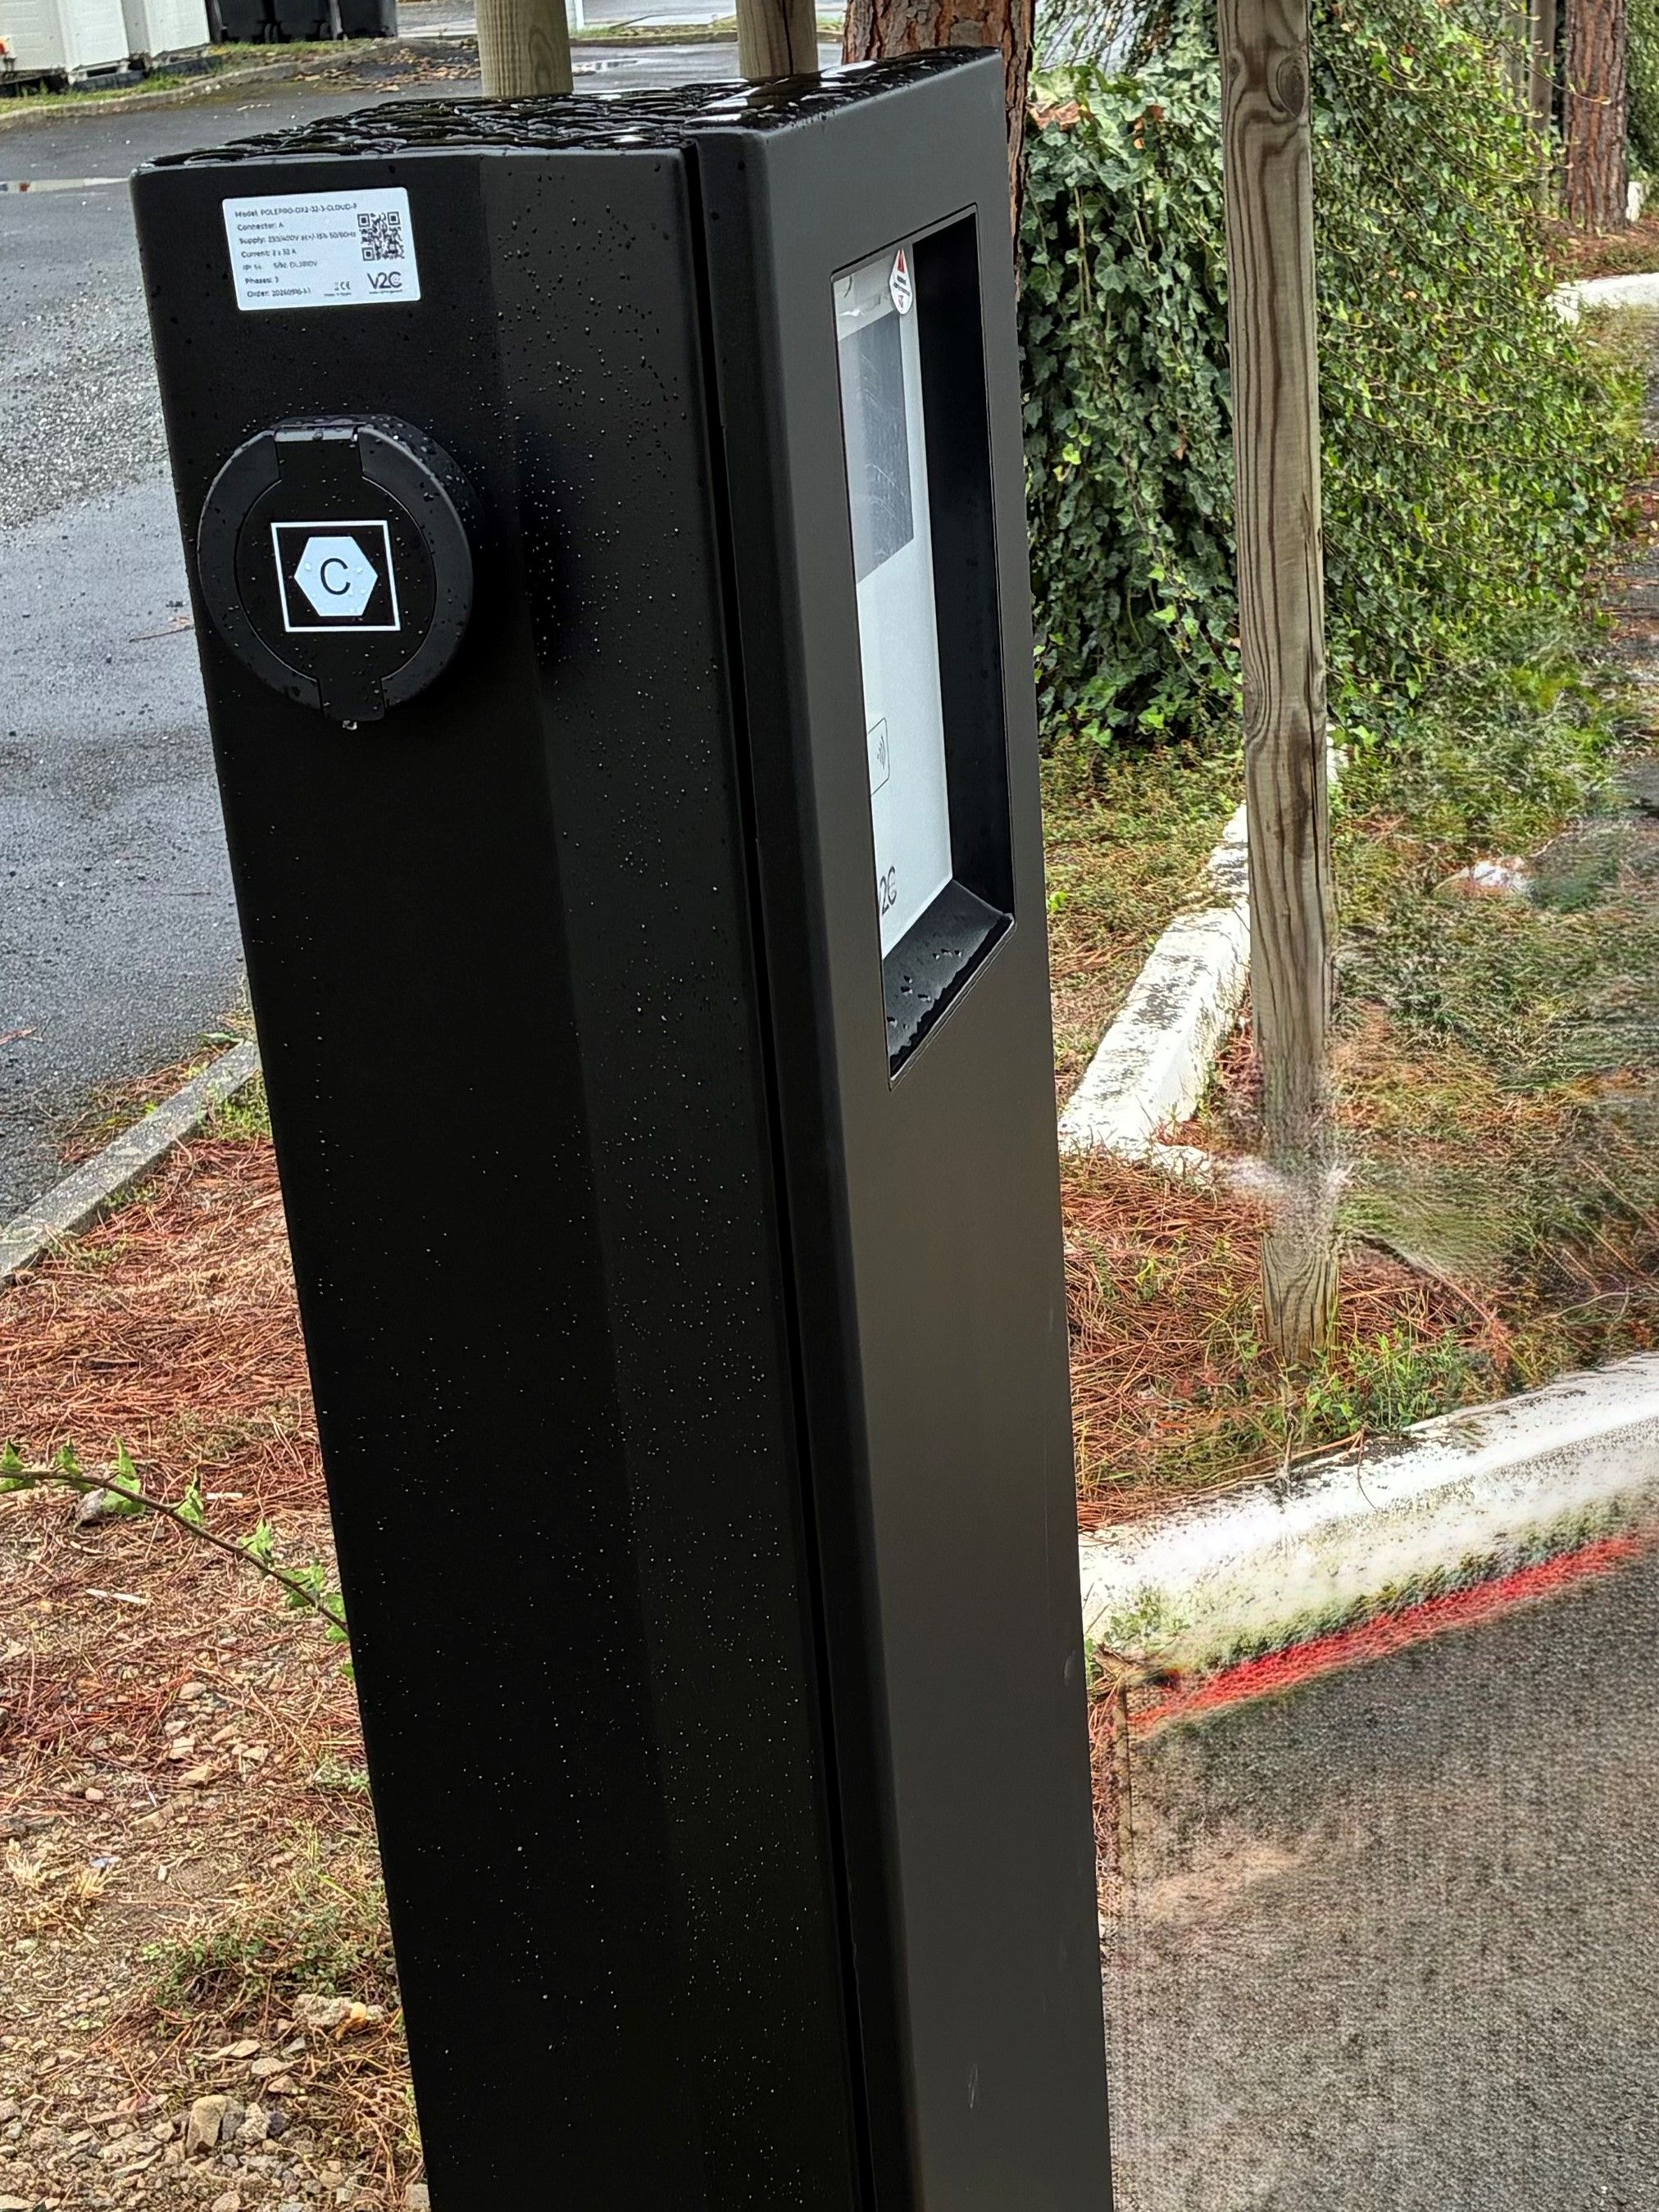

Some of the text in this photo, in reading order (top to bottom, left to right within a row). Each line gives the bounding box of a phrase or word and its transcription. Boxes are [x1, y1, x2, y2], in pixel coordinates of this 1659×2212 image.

[237, 222, 276, 231] Connector:
[239, 236, 266, 245] Supply:
[366, 270, 402, 289] V2C
[320, 557, 351, 596] C
[879, 865, 898, 916] 2C
